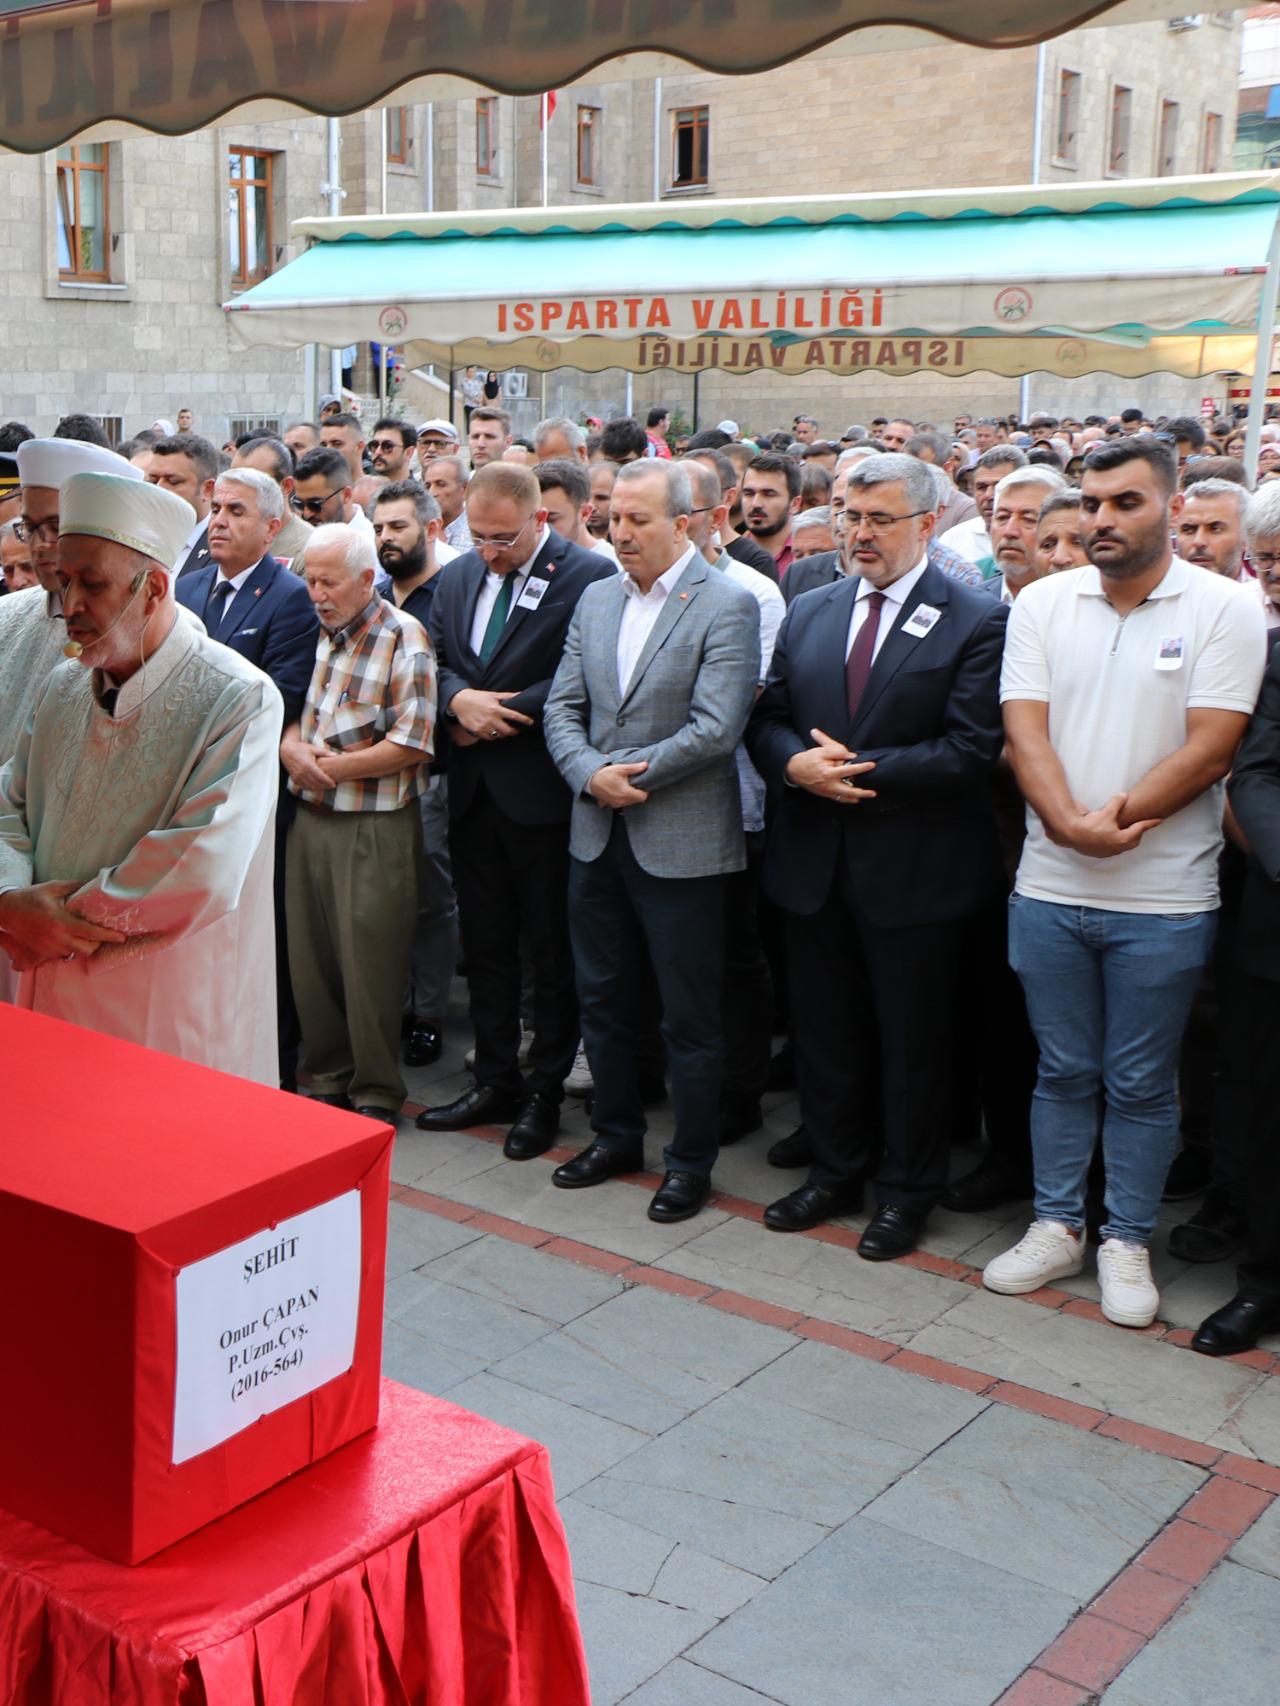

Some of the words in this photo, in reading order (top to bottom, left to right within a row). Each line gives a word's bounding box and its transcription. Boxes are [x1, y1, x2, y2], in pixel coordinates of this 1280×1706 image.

[497, 297, 672, 333] ISPARTA
[691, 287, 883, 329] VALİLİĞİ
[242, 1236, 300, 1284] ŞEHİT
[219, 1320, 258, 1350] Onur
[262, 1285, 320, 1329] ÇAPAN
[227, 1323, 309, 1375] P.Uzm.Çvş.
[230, 1348, 304, 1402] (2016-564)
